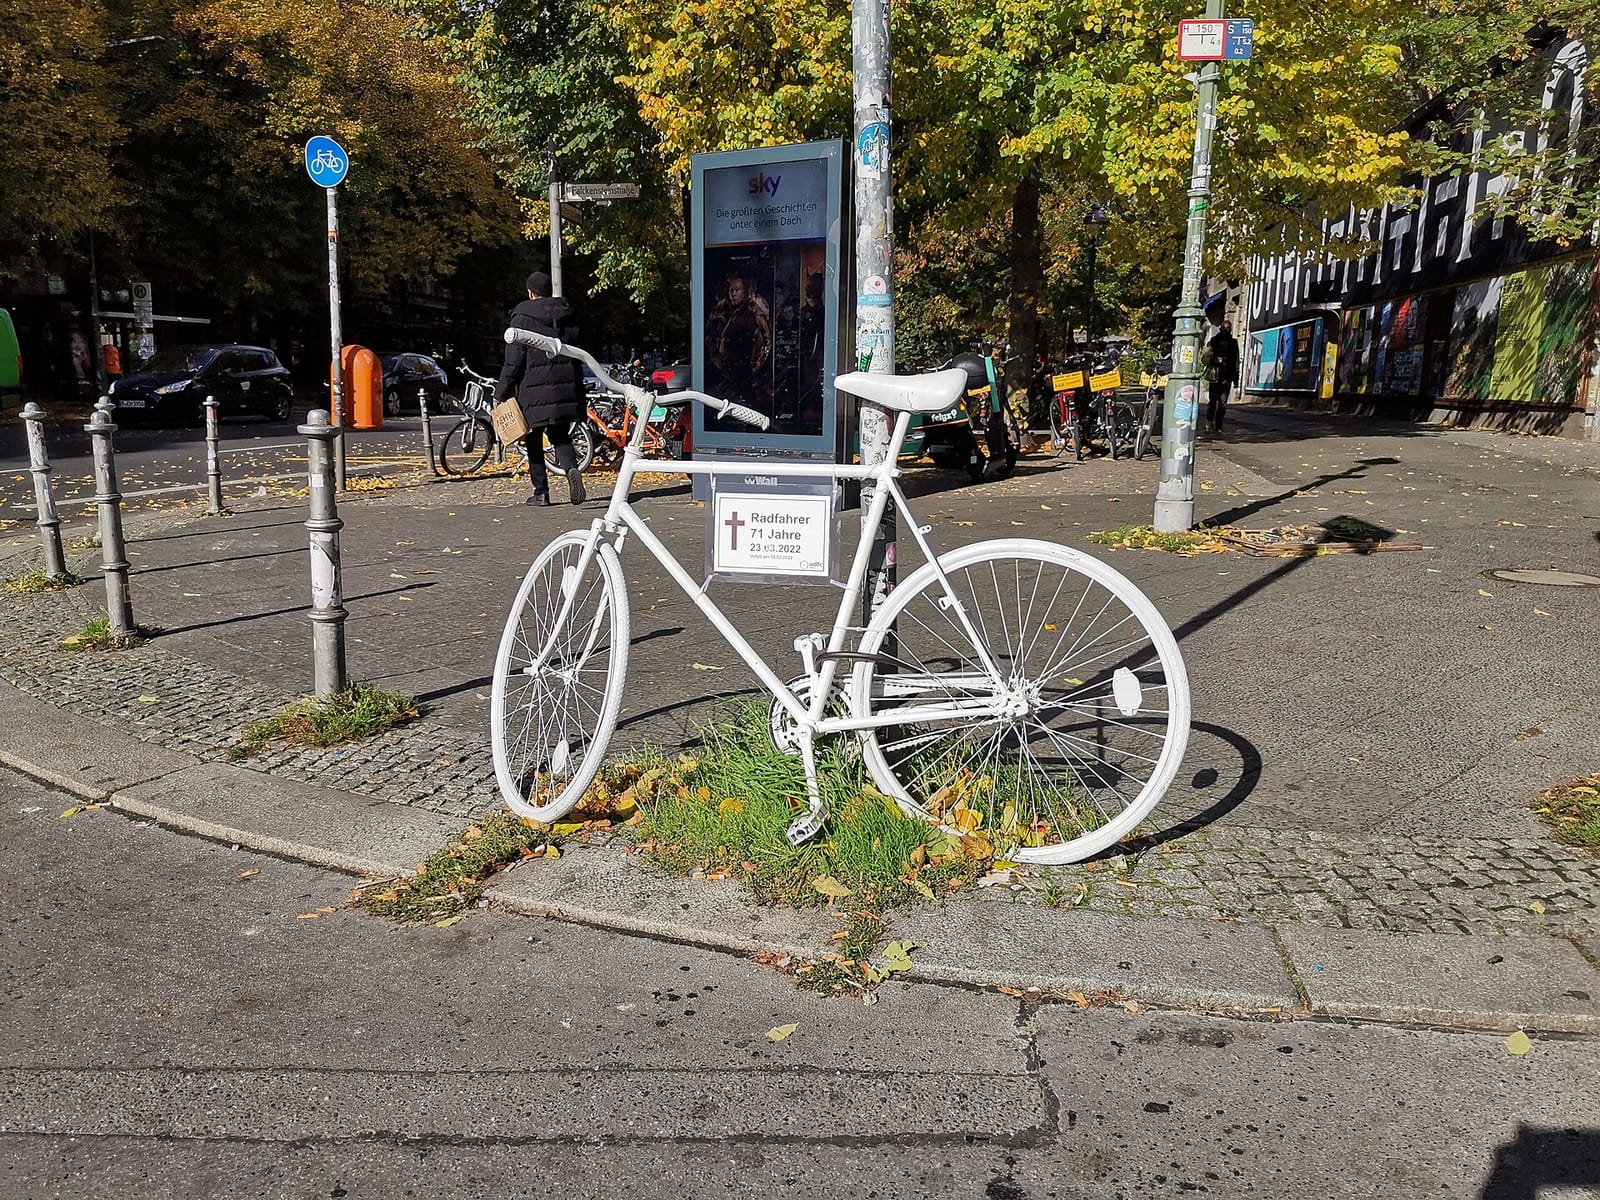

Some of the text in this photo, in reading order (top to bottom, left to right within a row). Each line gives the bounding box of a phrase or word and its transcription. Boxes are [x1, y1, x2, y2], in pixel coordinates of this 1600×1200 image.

[1183, 25, 1213, 33] H 150
[1227, 25, 1235, 34] S
[749, 172, 782, 197] sky
[716, 202, 817, 219] Die größten Geschichten
[730, 216, 802, 230] unter einem Dach
[751, 512, 811, 525] Radfahrer
[751, 528, 801, 540] 71 Jahre
